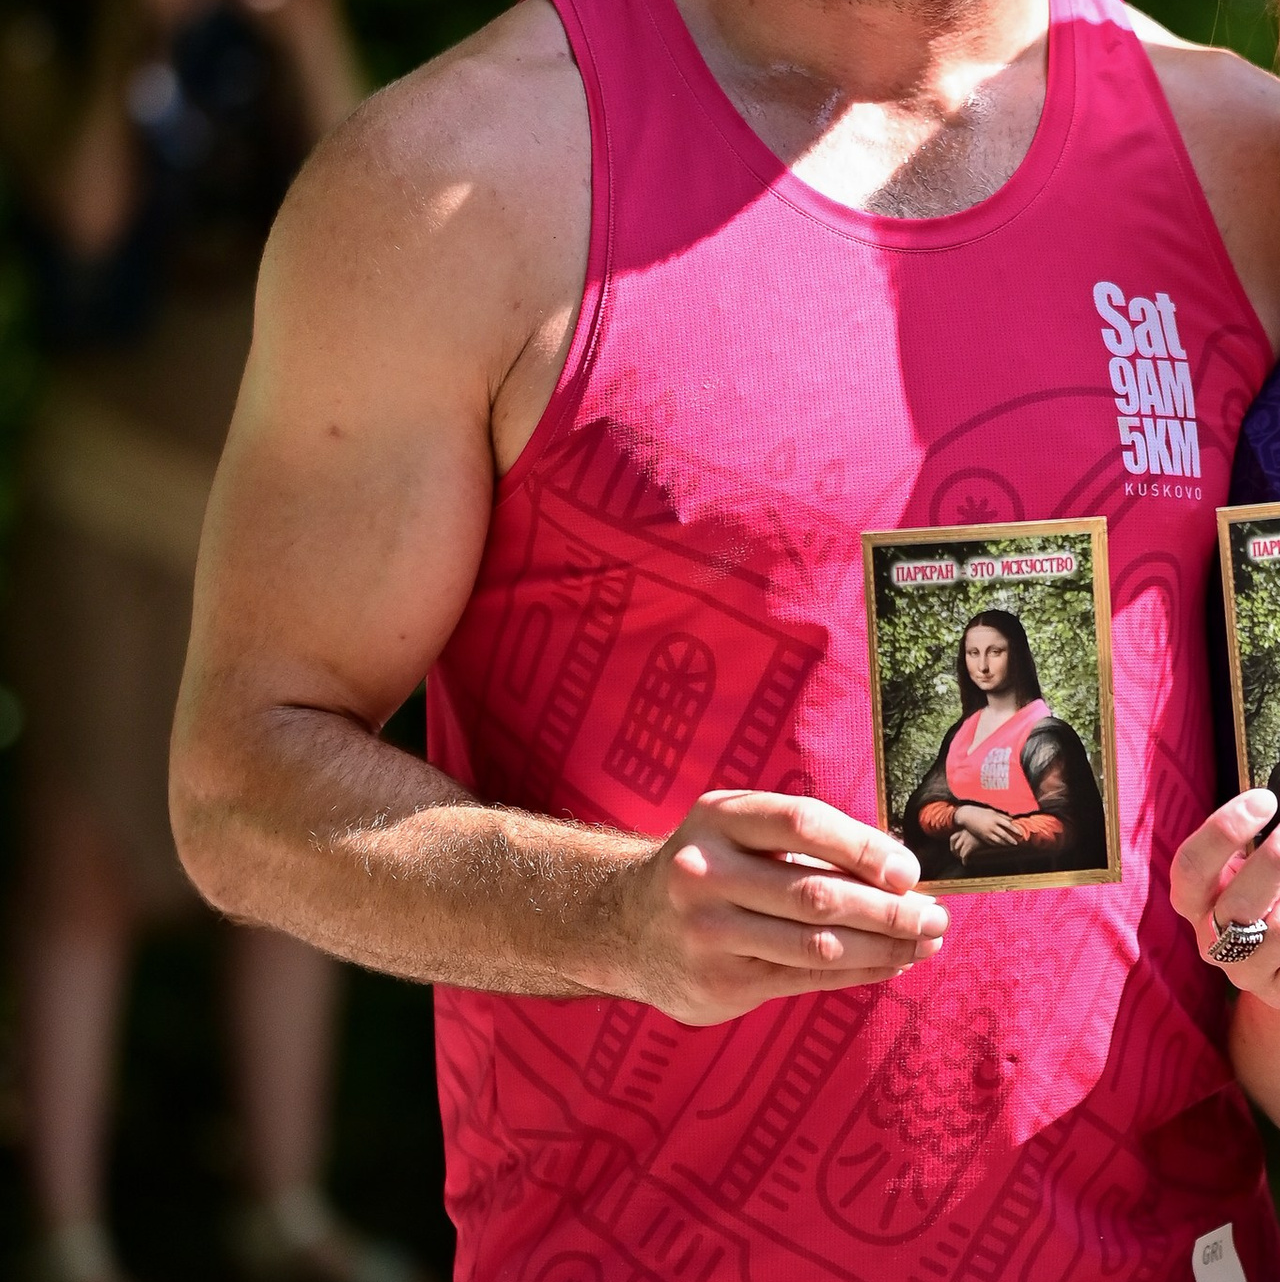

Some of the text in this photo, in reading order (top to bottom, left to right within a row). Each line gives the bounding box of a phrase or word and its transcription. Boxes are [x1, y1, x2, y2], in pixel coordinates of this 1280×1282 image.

[1092, 281, 1187, 360] Sat
[1108, 356, 1196, 418] 9AM
[1117, 416, 1202, 478] 5KM
[1125, 482, 1202, 500] KUSKOVO
[896, 564, 954, 582] ПАРКРАН
[970, 561, 994, 579] ЭТО
[1001, 556, 1073, 577] ИСКУССТВО
